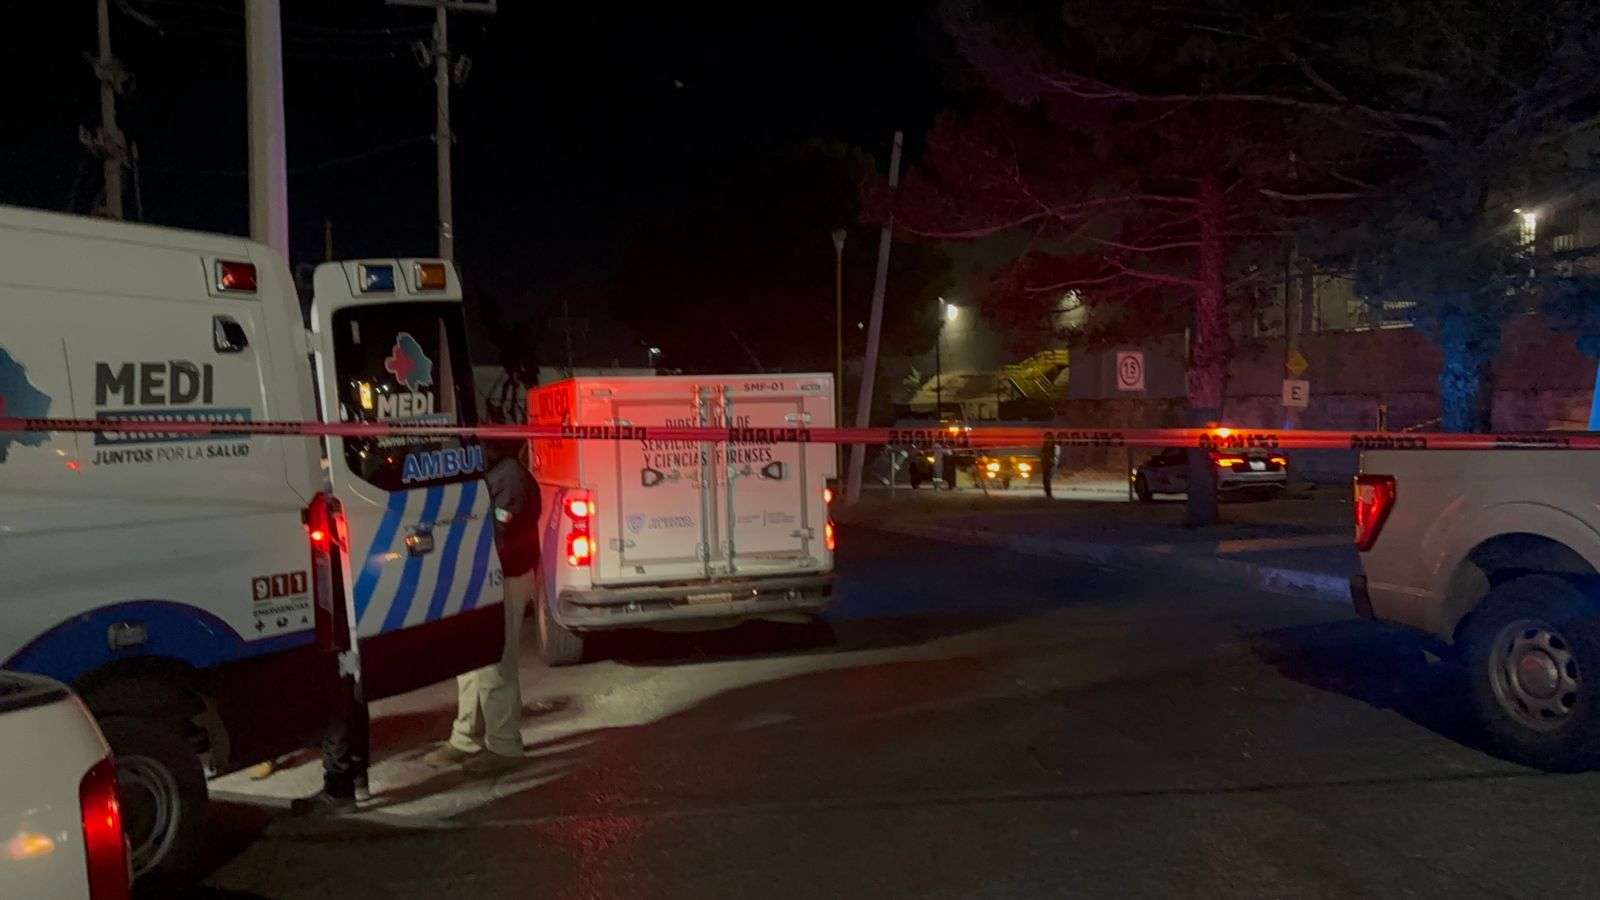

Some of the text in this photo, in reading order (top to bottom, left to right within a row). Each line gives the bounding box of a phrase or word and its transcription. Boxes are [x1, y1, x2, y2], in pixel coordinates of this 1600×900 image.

[96, 361, 213, 406] MEDI
[1291, 386, 1302, 400] E
[377, 391, 434, 420] MEDI
[92, 444, 250, 466] JUNTOS POR LA SALUD
[654, 451, 708, 468] CIENCIAS
[253, 572, 306, 600] 911
